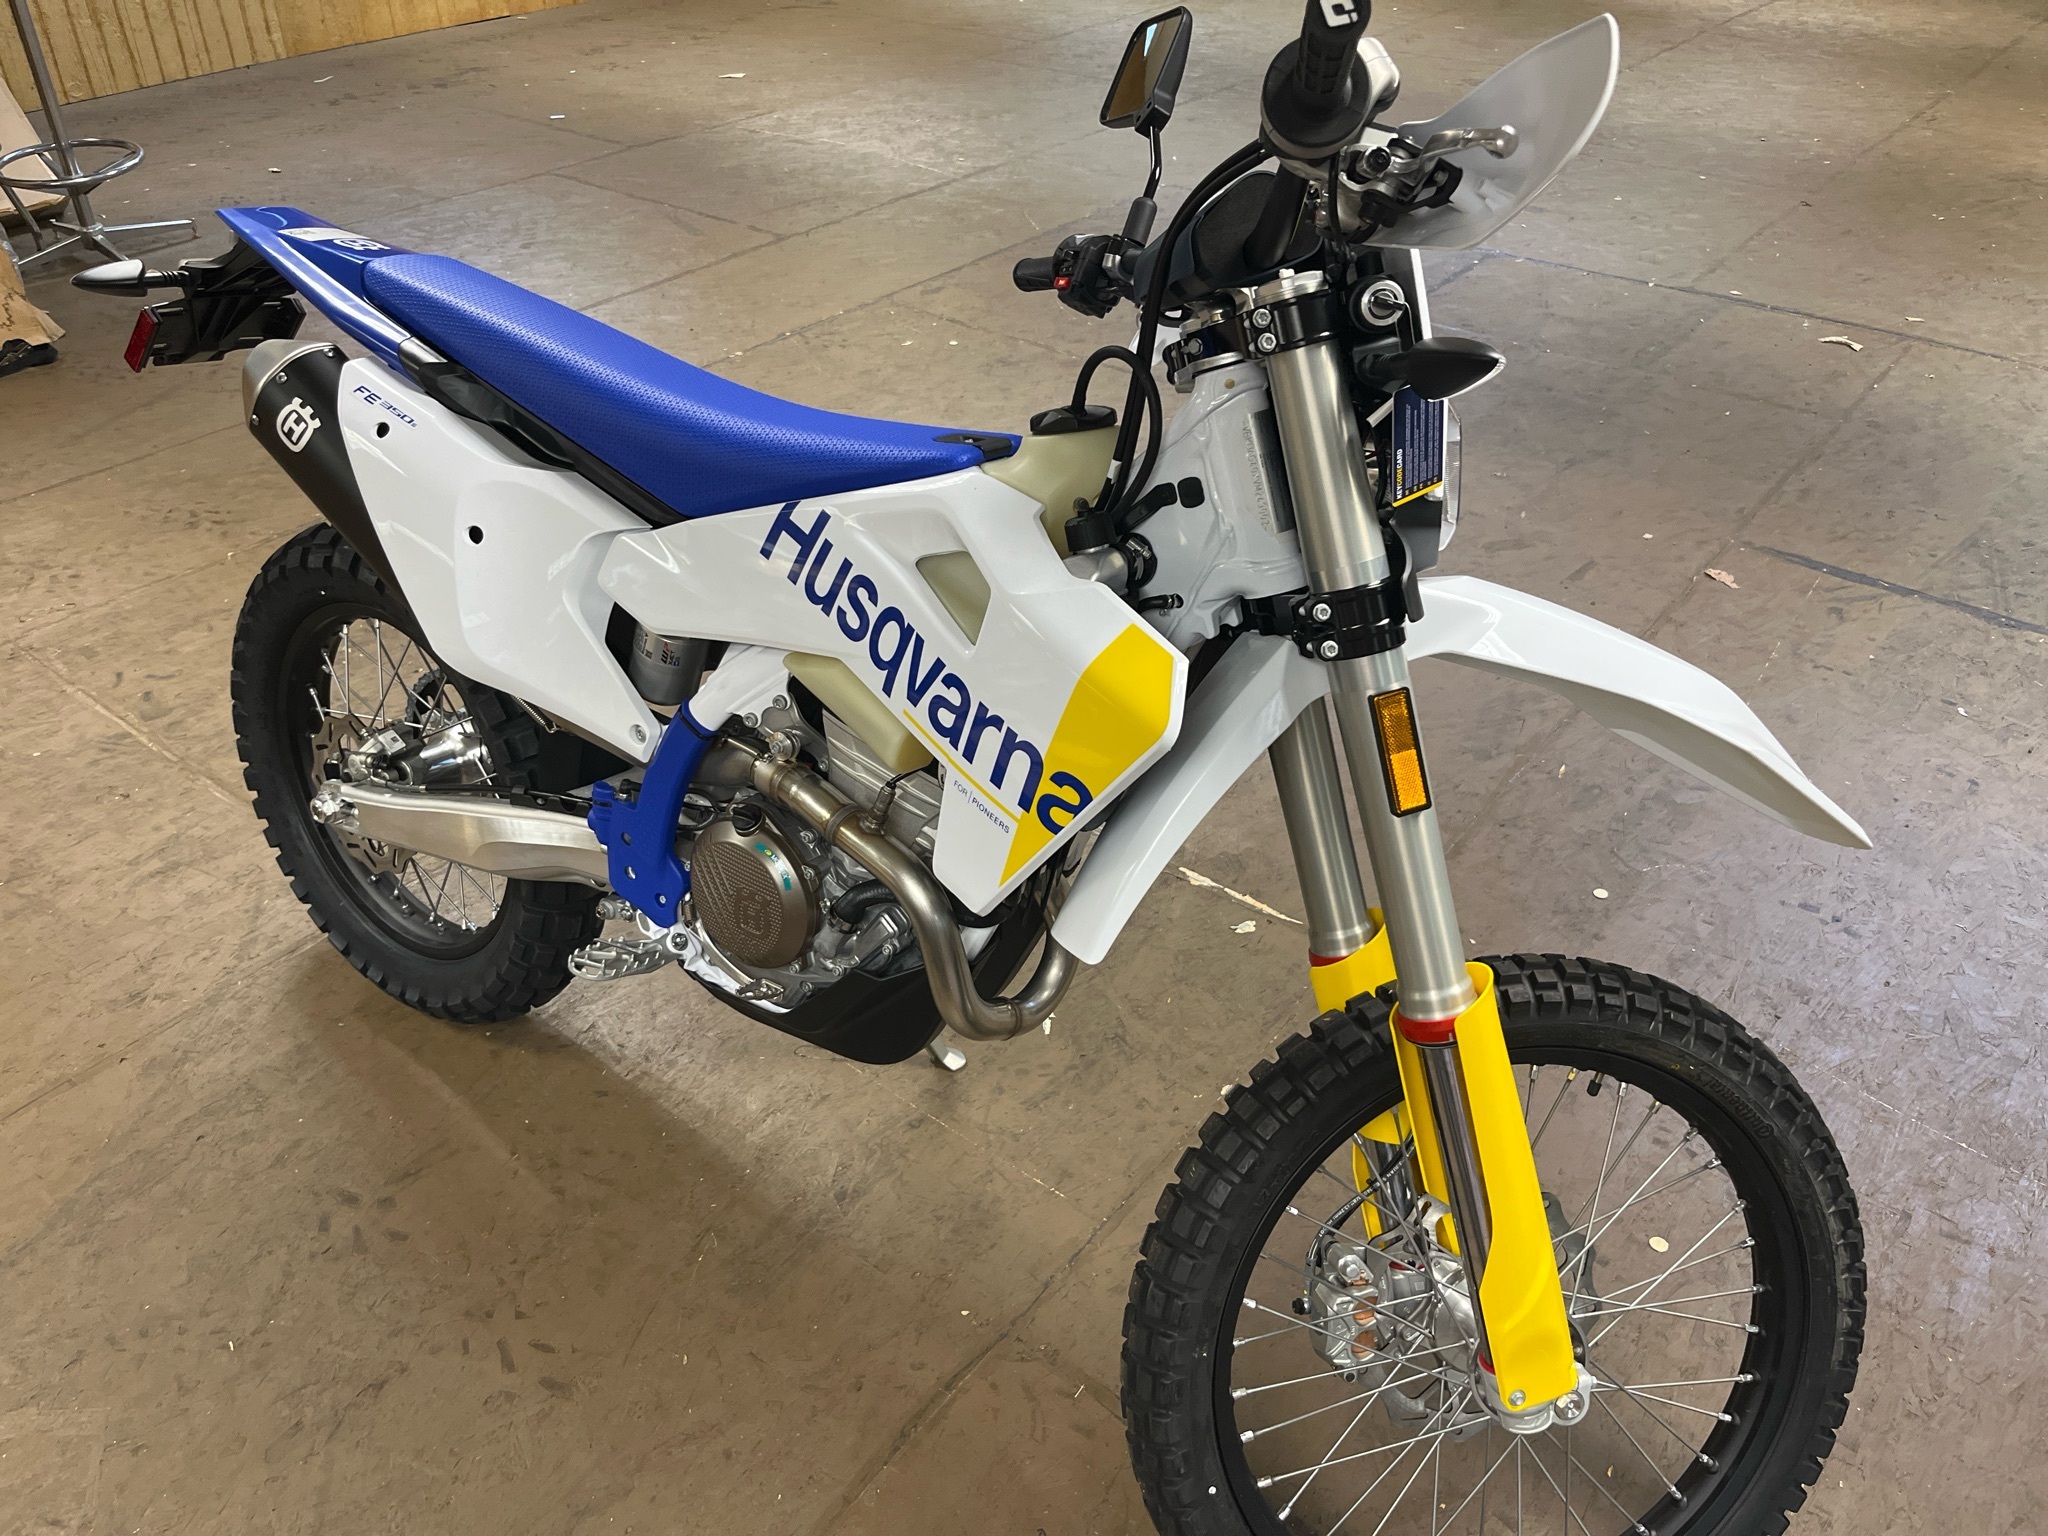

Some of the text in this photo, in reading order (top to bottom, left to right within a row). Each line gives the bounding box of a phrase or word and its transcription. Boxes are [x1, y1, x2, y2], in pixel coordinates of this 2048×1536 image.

[353, 385, 382, 405] FE
[759, 501, 1094, 836] Husqvarna
[953, 780, 1011, 834] FOR PIONEERS
